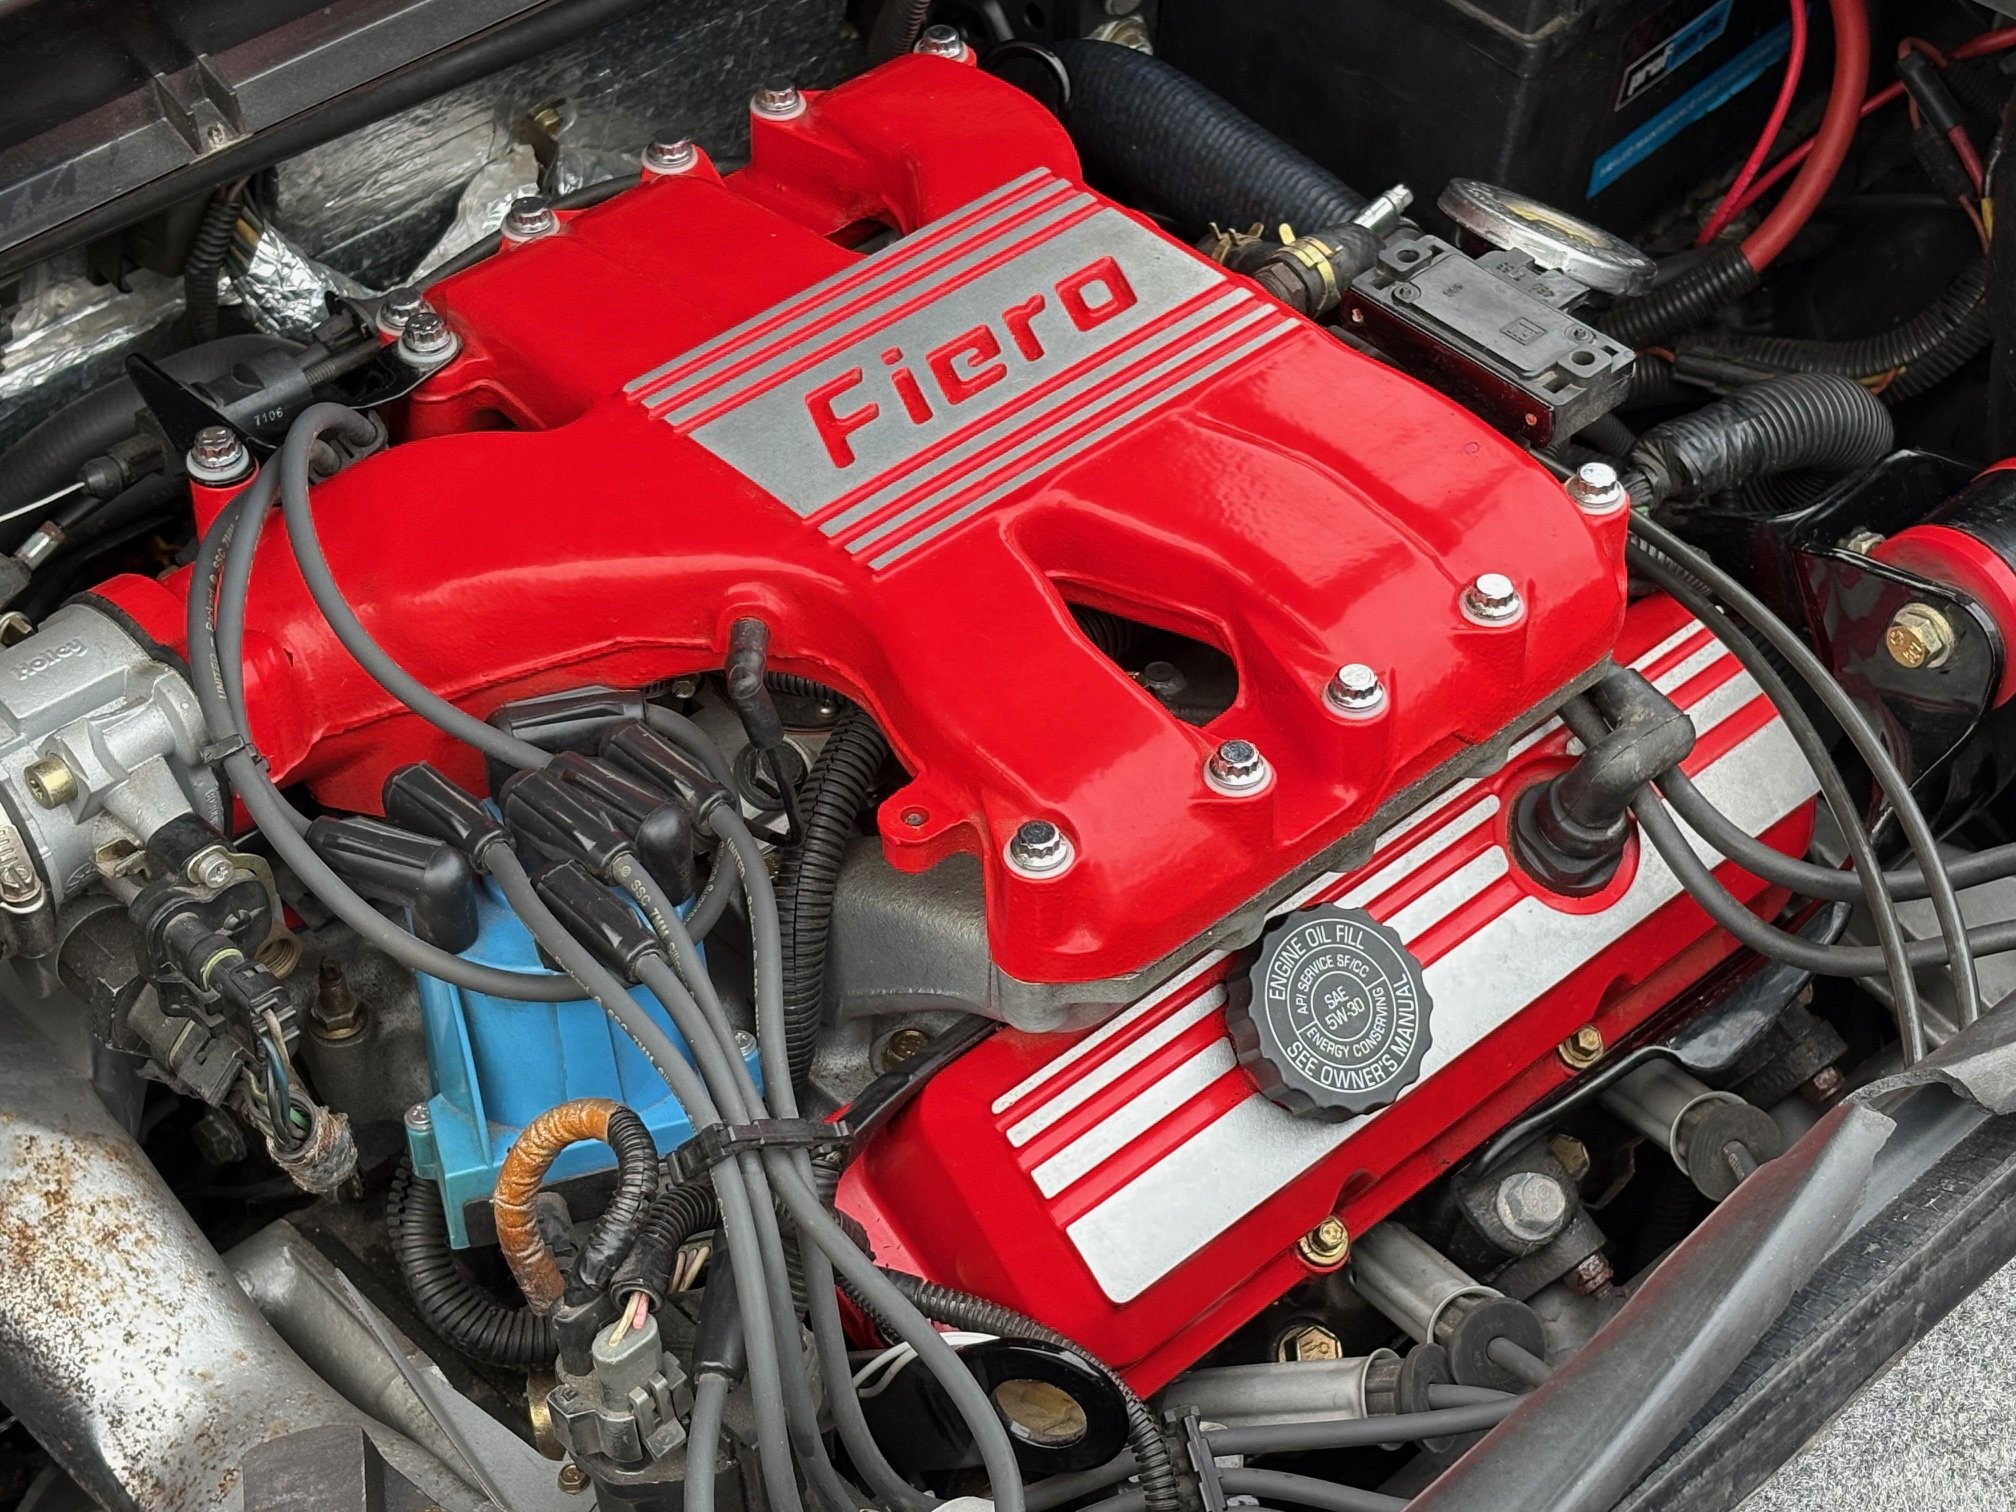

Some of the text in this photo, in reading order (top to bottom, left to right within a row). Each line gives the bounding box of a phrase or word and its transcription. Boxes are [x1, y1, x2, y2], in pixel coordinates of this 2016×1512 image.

[804, 255, 1138, 469] Fiero
[254, 406, 284, 427] 7106
[630, 879, 651, 907] SSC
[649, 906, 670, 940] 7MM
[1269, 924, 1365, 1001] ENGINE OIL FILL
[1295, 954, 1370, 1015] API SERVICE SF/CC
[1305, 986, 1388, 1058] ENERGY CONSERVING
[1323, 985, 1350, 1010] SAE
[1324, 996, 1365, 1031] 5W-30
[1286, 972, 1415, 1090] SEE OWNER'S MANUAL
